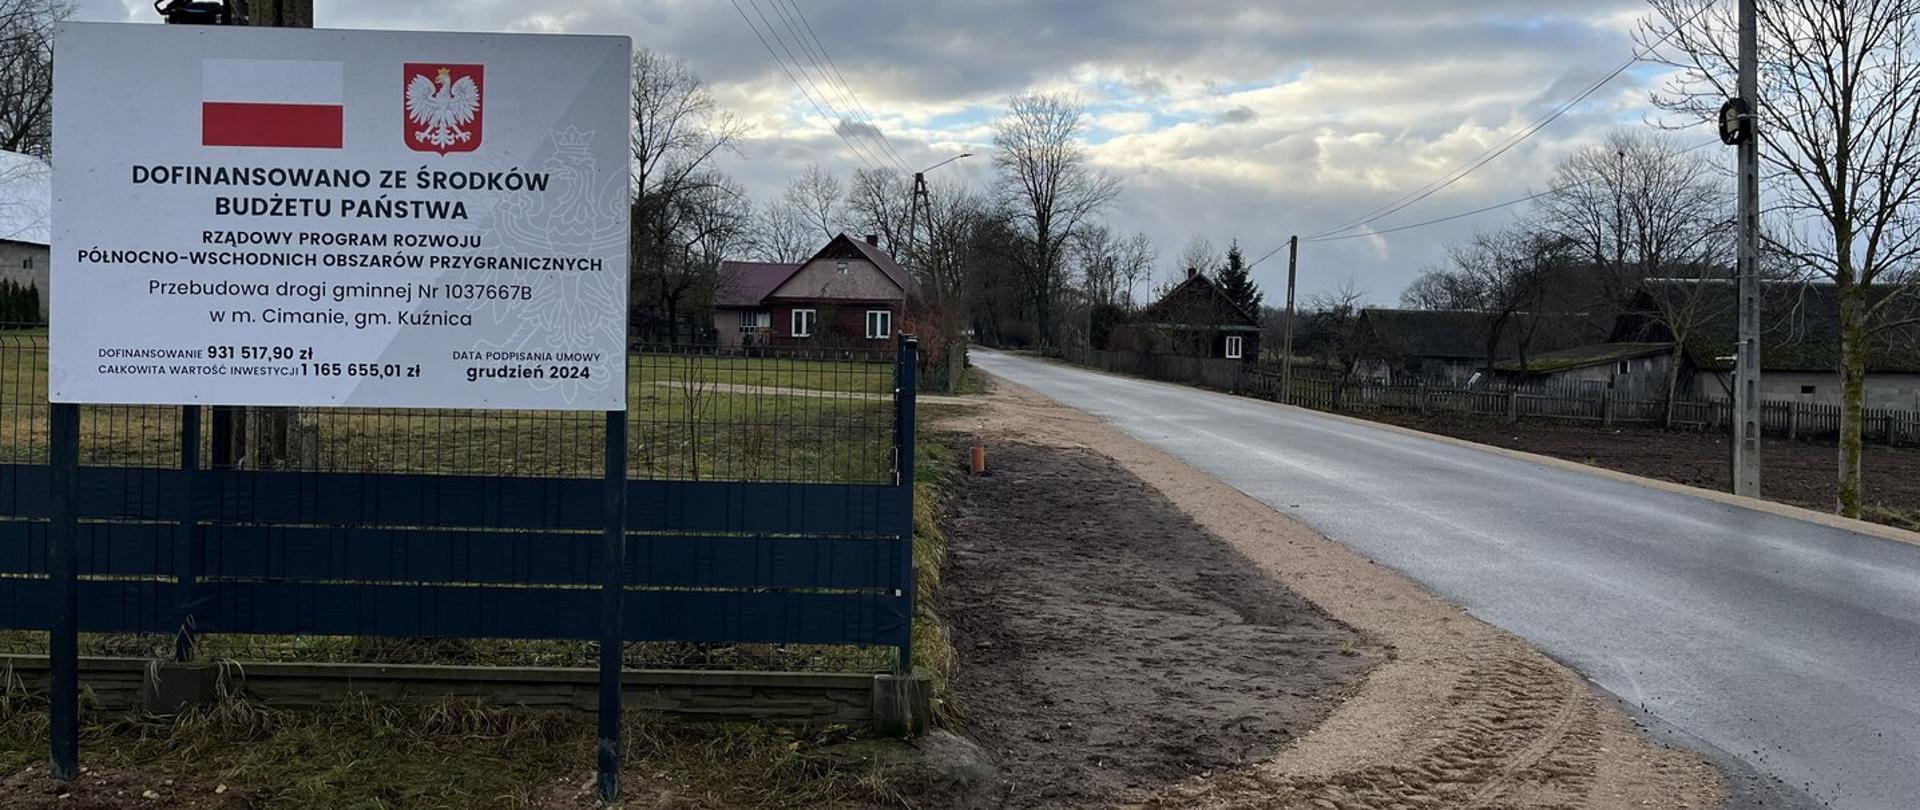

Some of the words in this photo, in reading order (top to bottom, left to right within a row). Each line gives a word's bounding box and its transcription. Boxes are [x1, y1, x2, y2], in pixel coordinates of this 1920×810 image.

[132, 165, 371, 189] DOFINANSOWANO
[379, 169, 407, 189] ZE
[416, 164, 550, 192] ŚRODKÓW
[215, 192, 331, 218] BUDŻETU
[341, 193, 469, 220] PAŃSTWA
[202, 230, 293, 248] RZĄDOWY
[299, 232, 388, 247] PROGRAM
[393, 233, 482, 249] ROZWOJU
[78, 247, 317, 267] PÓŁNOCNO-WSCHODNICH
[322, 250, 425, 269] OBSZARÓW
[429, 255, 602, 272] PRZYGRANICZNYCH
[149, 279, 270, 296] Przebudowa
[275, 281, 326, 302] drogi
[332, 281, 412, 304] gminnej
[418, 284, 440, 299] Nr
[444, 283, 532, 301] 1037667B
[209, 310, 226, 323] w
[231, 310, 256, 323] m.
[261, 307, 349, 327] Cimanie,
[354, 312, 392, 330] gm.
[398, 309, 472, 327] Kuźnica
[98, 348, 203, 359] DOFINANSOWANIE
[207, 345, 235, 359] 931
[241, 345, 294, 363] 517,90
[299, 346, 314, 361] zł
[452, 350, 483, 361] DATA
[485, 351, 553, 362] PODPISANIA
[555, 352, 601, 362] UMOWY
[98, 364, 166, 375] CAŁKOWITA
[169, 363, 227, 375] WARTOŚĆ
[230, 366, 299, 377] INWESTYCJI
[301, 362, 307, 376] 1
[313, 362, 342, 377] 165
[347, 362, 401, 380] 655,01
[406, 364, 421, 378] zł
[466, 364, 544, 383] grudzień
[549, 365, 591, 380] 2024
